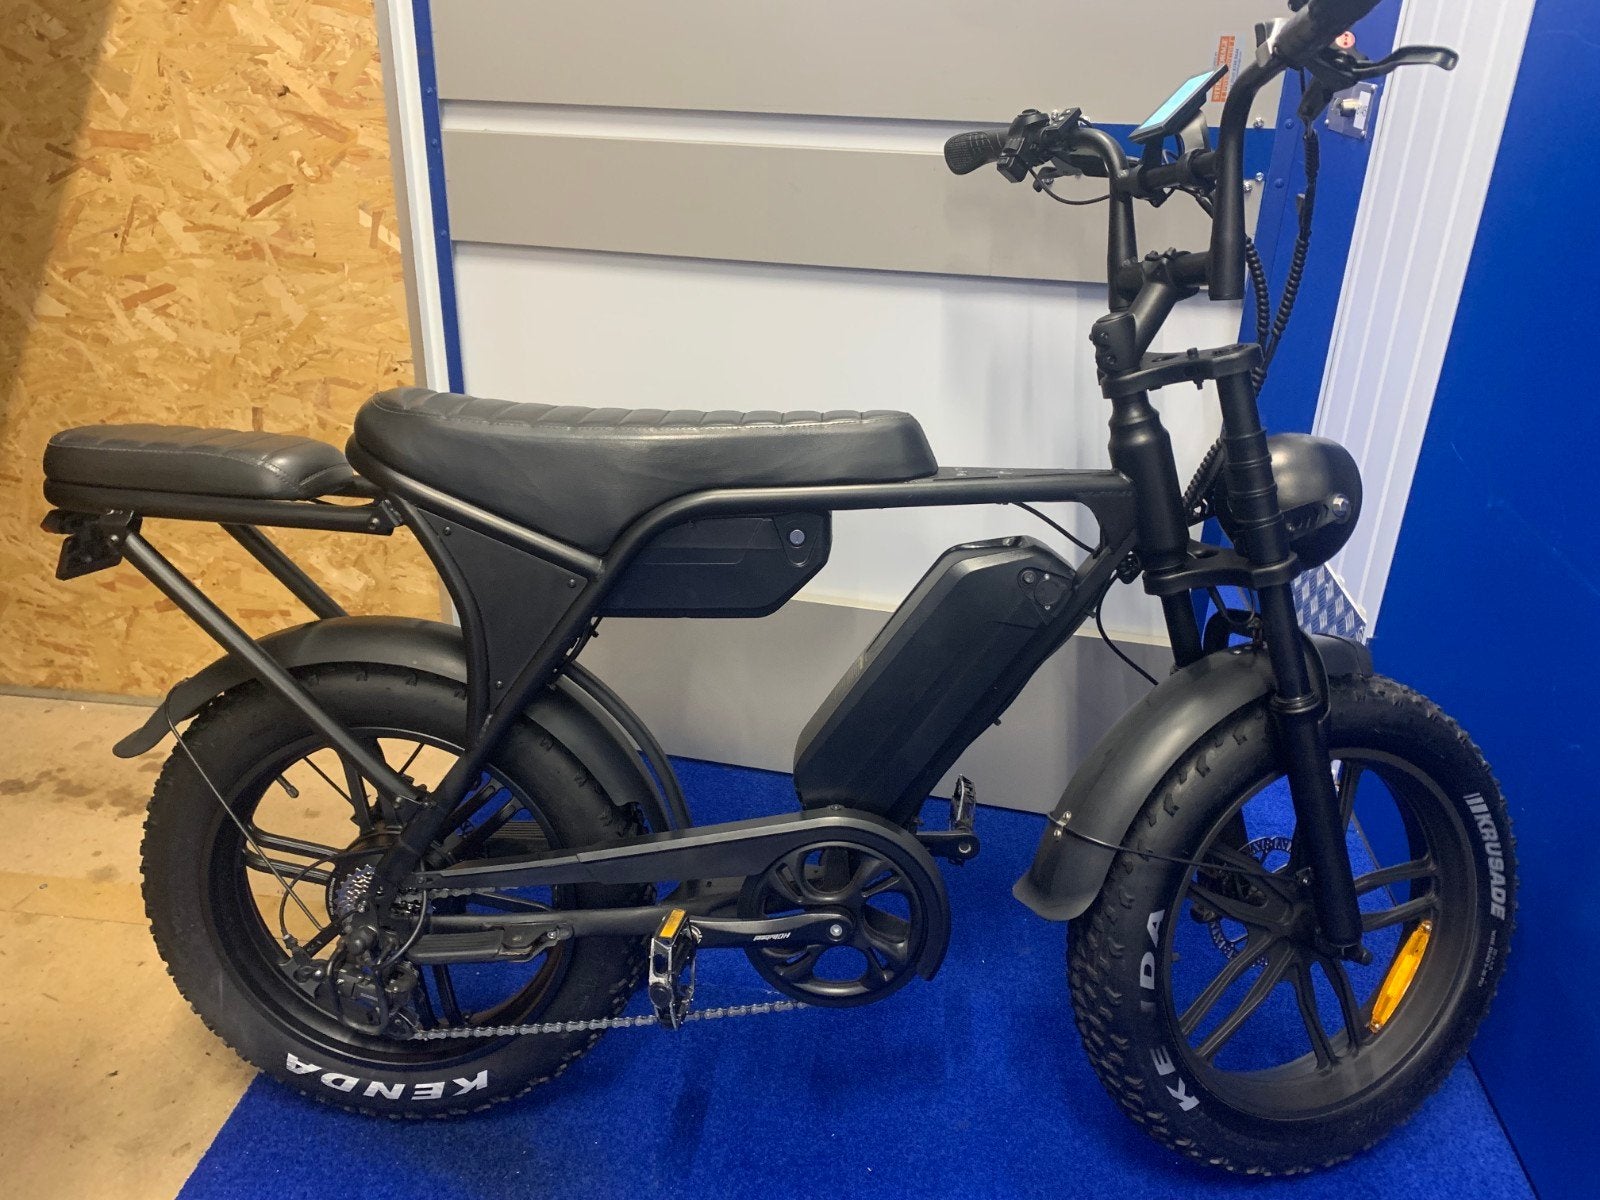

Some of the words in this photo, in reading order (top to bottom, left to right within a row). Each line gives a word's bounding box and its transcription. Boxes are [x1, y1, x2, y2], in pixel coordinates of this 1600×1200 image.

[1473, 812, 1507, 921] KRUSADE
[1139, 909, 1200, 1112] KEDA
[286, 1052, 488, 1101] KENDA
